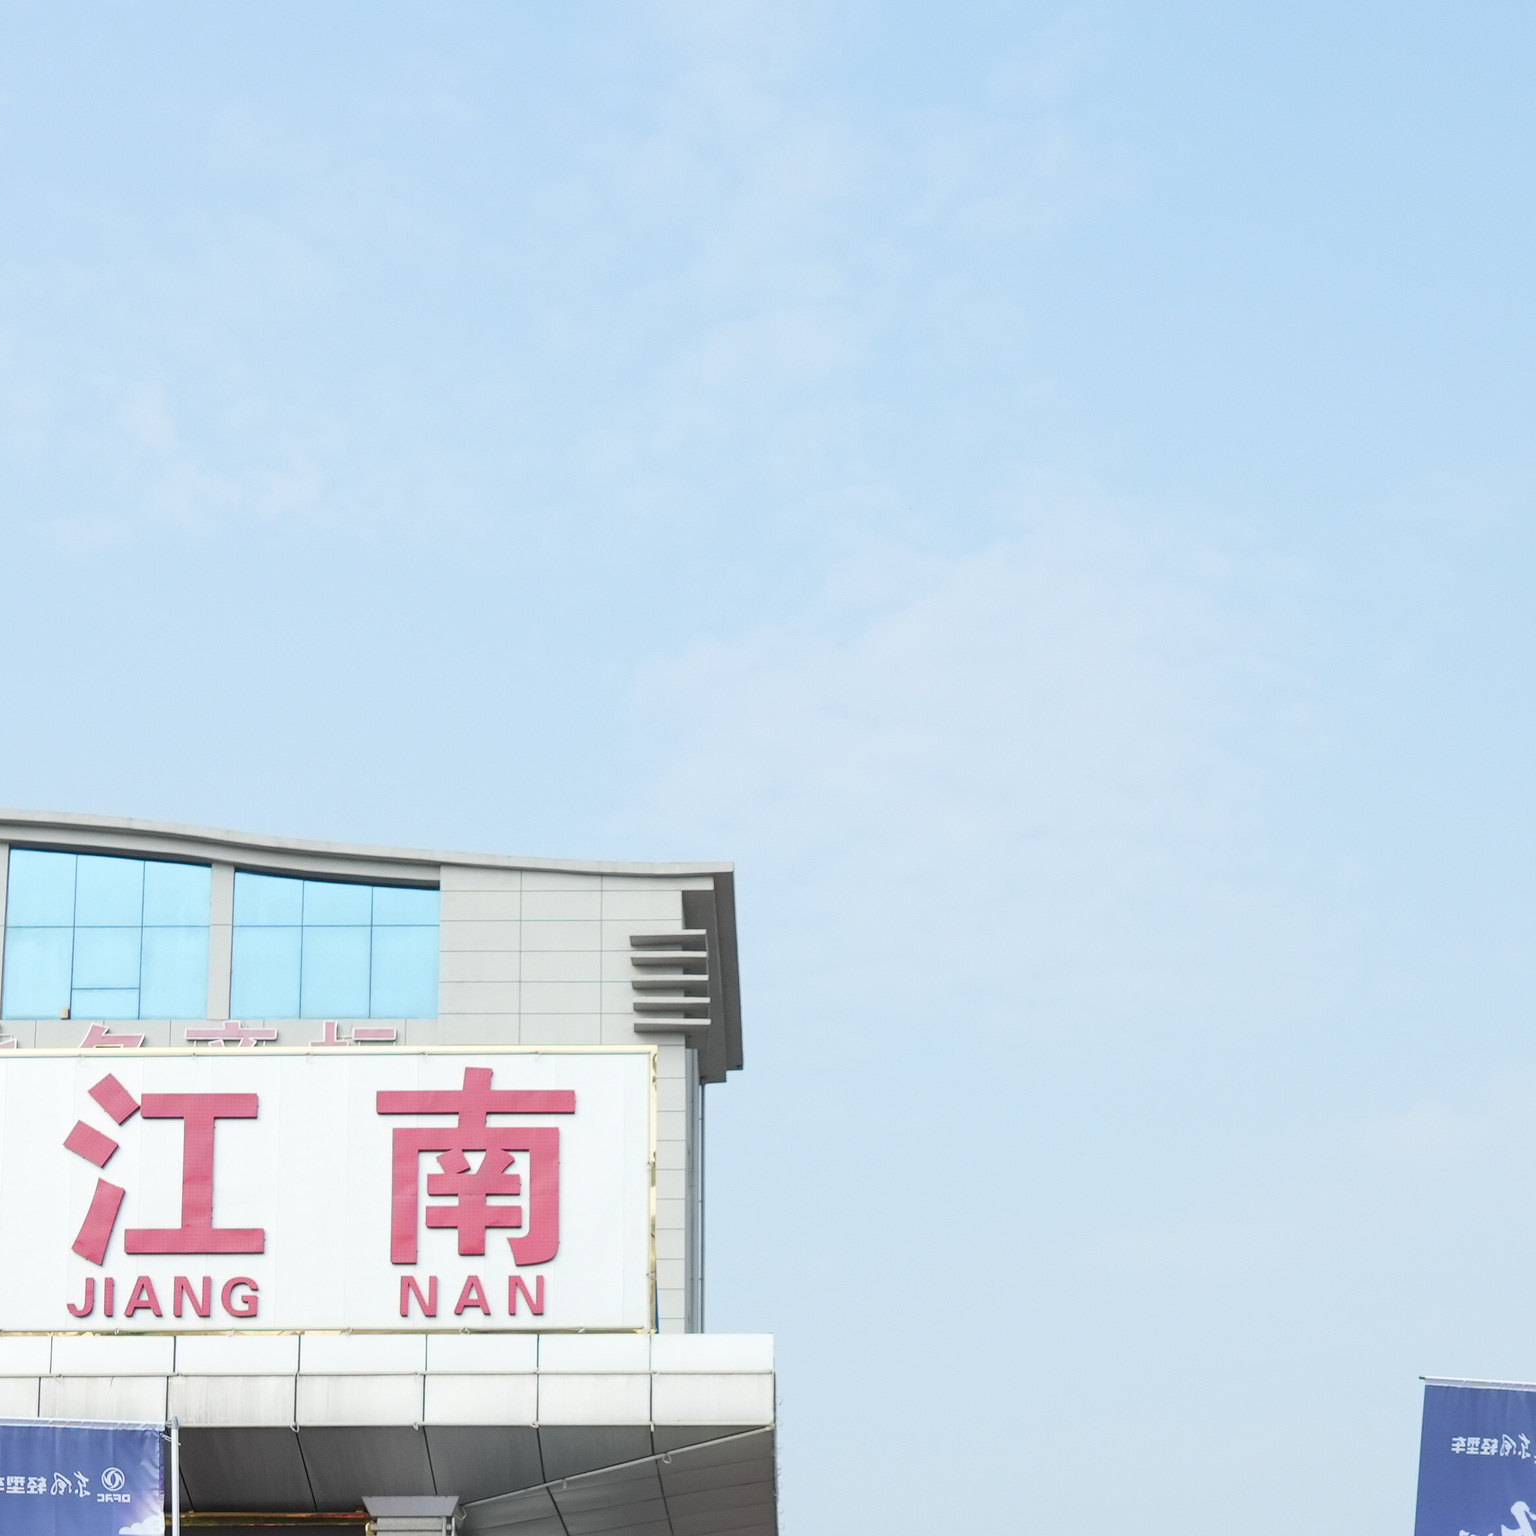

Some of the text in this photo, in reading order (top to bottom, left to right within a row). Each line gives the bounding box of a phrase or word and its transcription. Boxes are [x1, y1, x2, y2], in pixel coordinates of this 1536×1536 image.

[63, 1065, 577, 1268] 江南
[66, 1274, 260, 1319] JIANG
[399, 1273, 546, 1318] NAN
